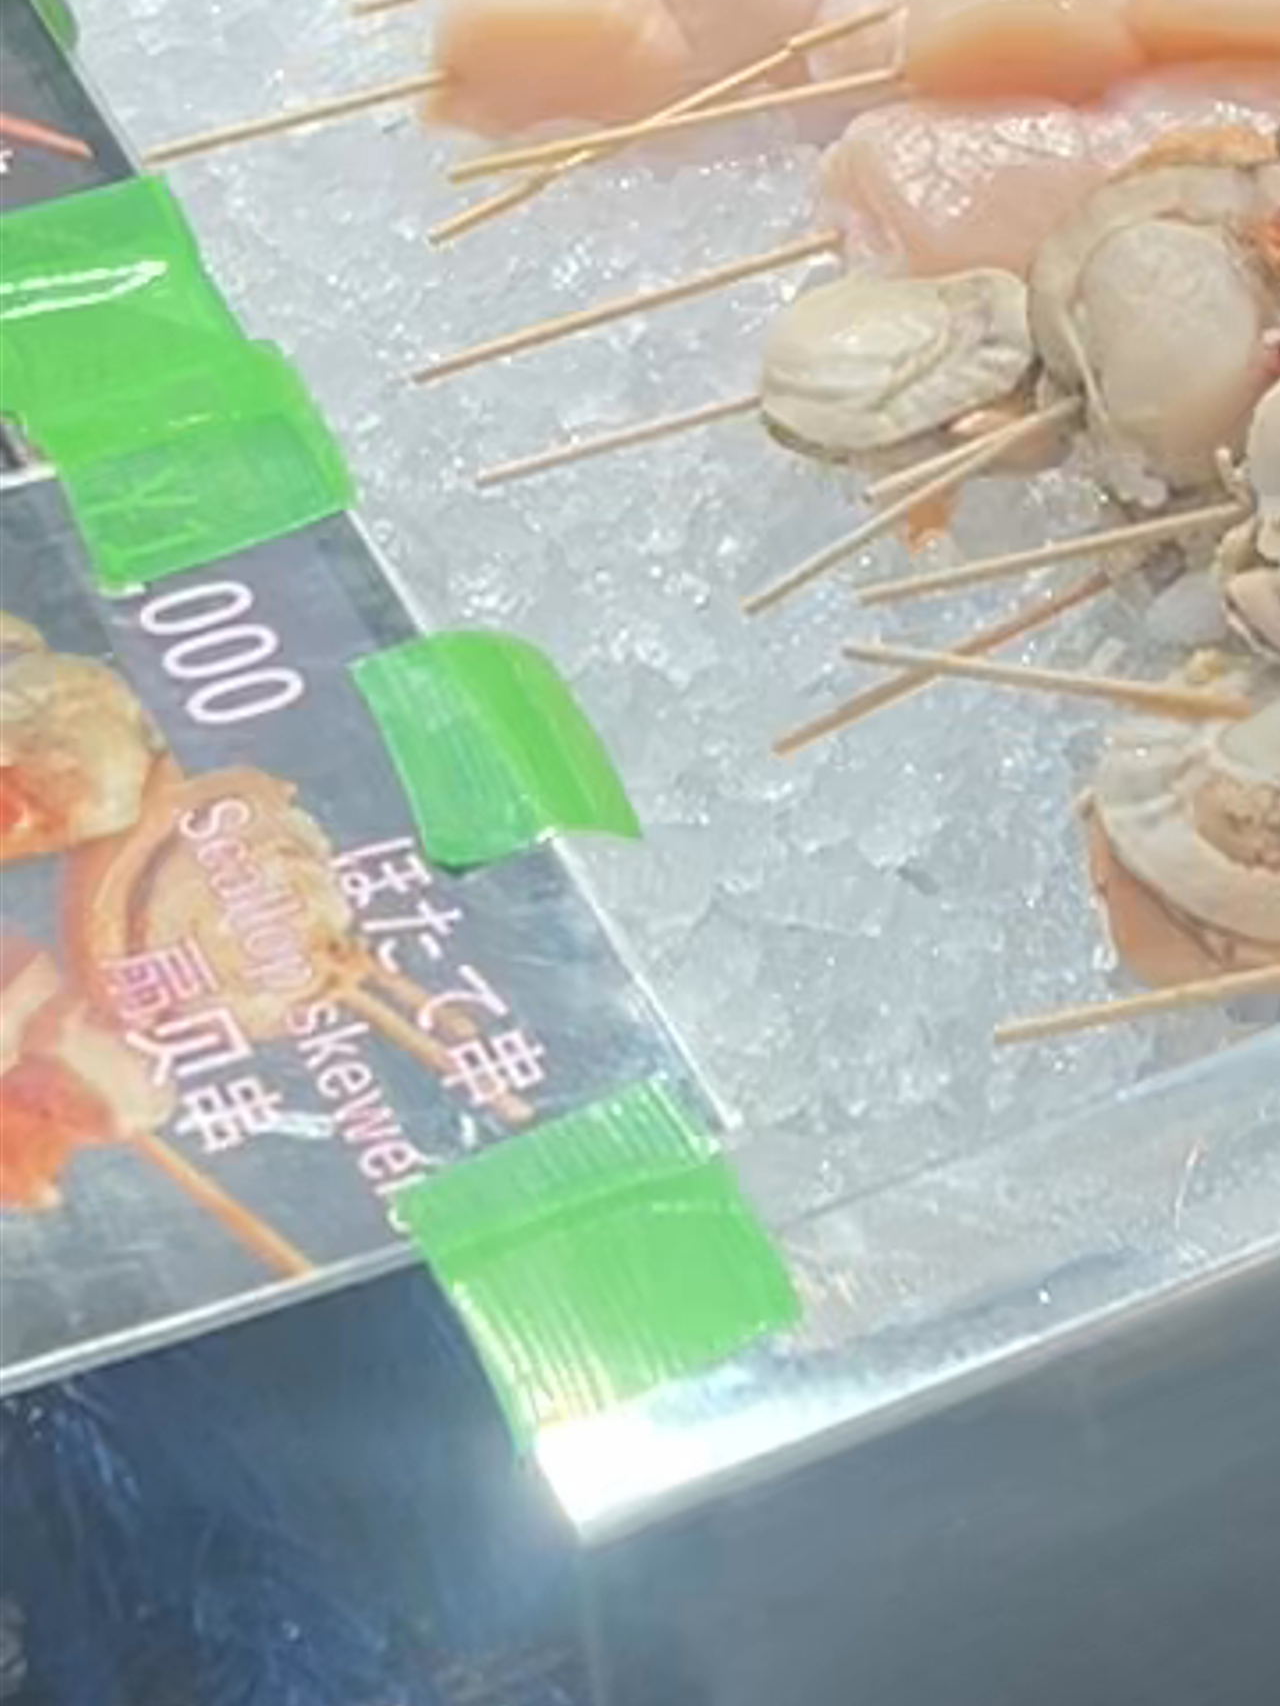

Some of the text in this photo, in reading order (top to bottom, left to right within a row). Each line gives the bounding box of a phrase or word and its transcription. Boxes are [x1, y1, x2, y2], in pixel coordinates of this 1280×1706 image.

[178, 798, 315, 988] Scallop
[330, 837, 546, 1108] ほたて串
